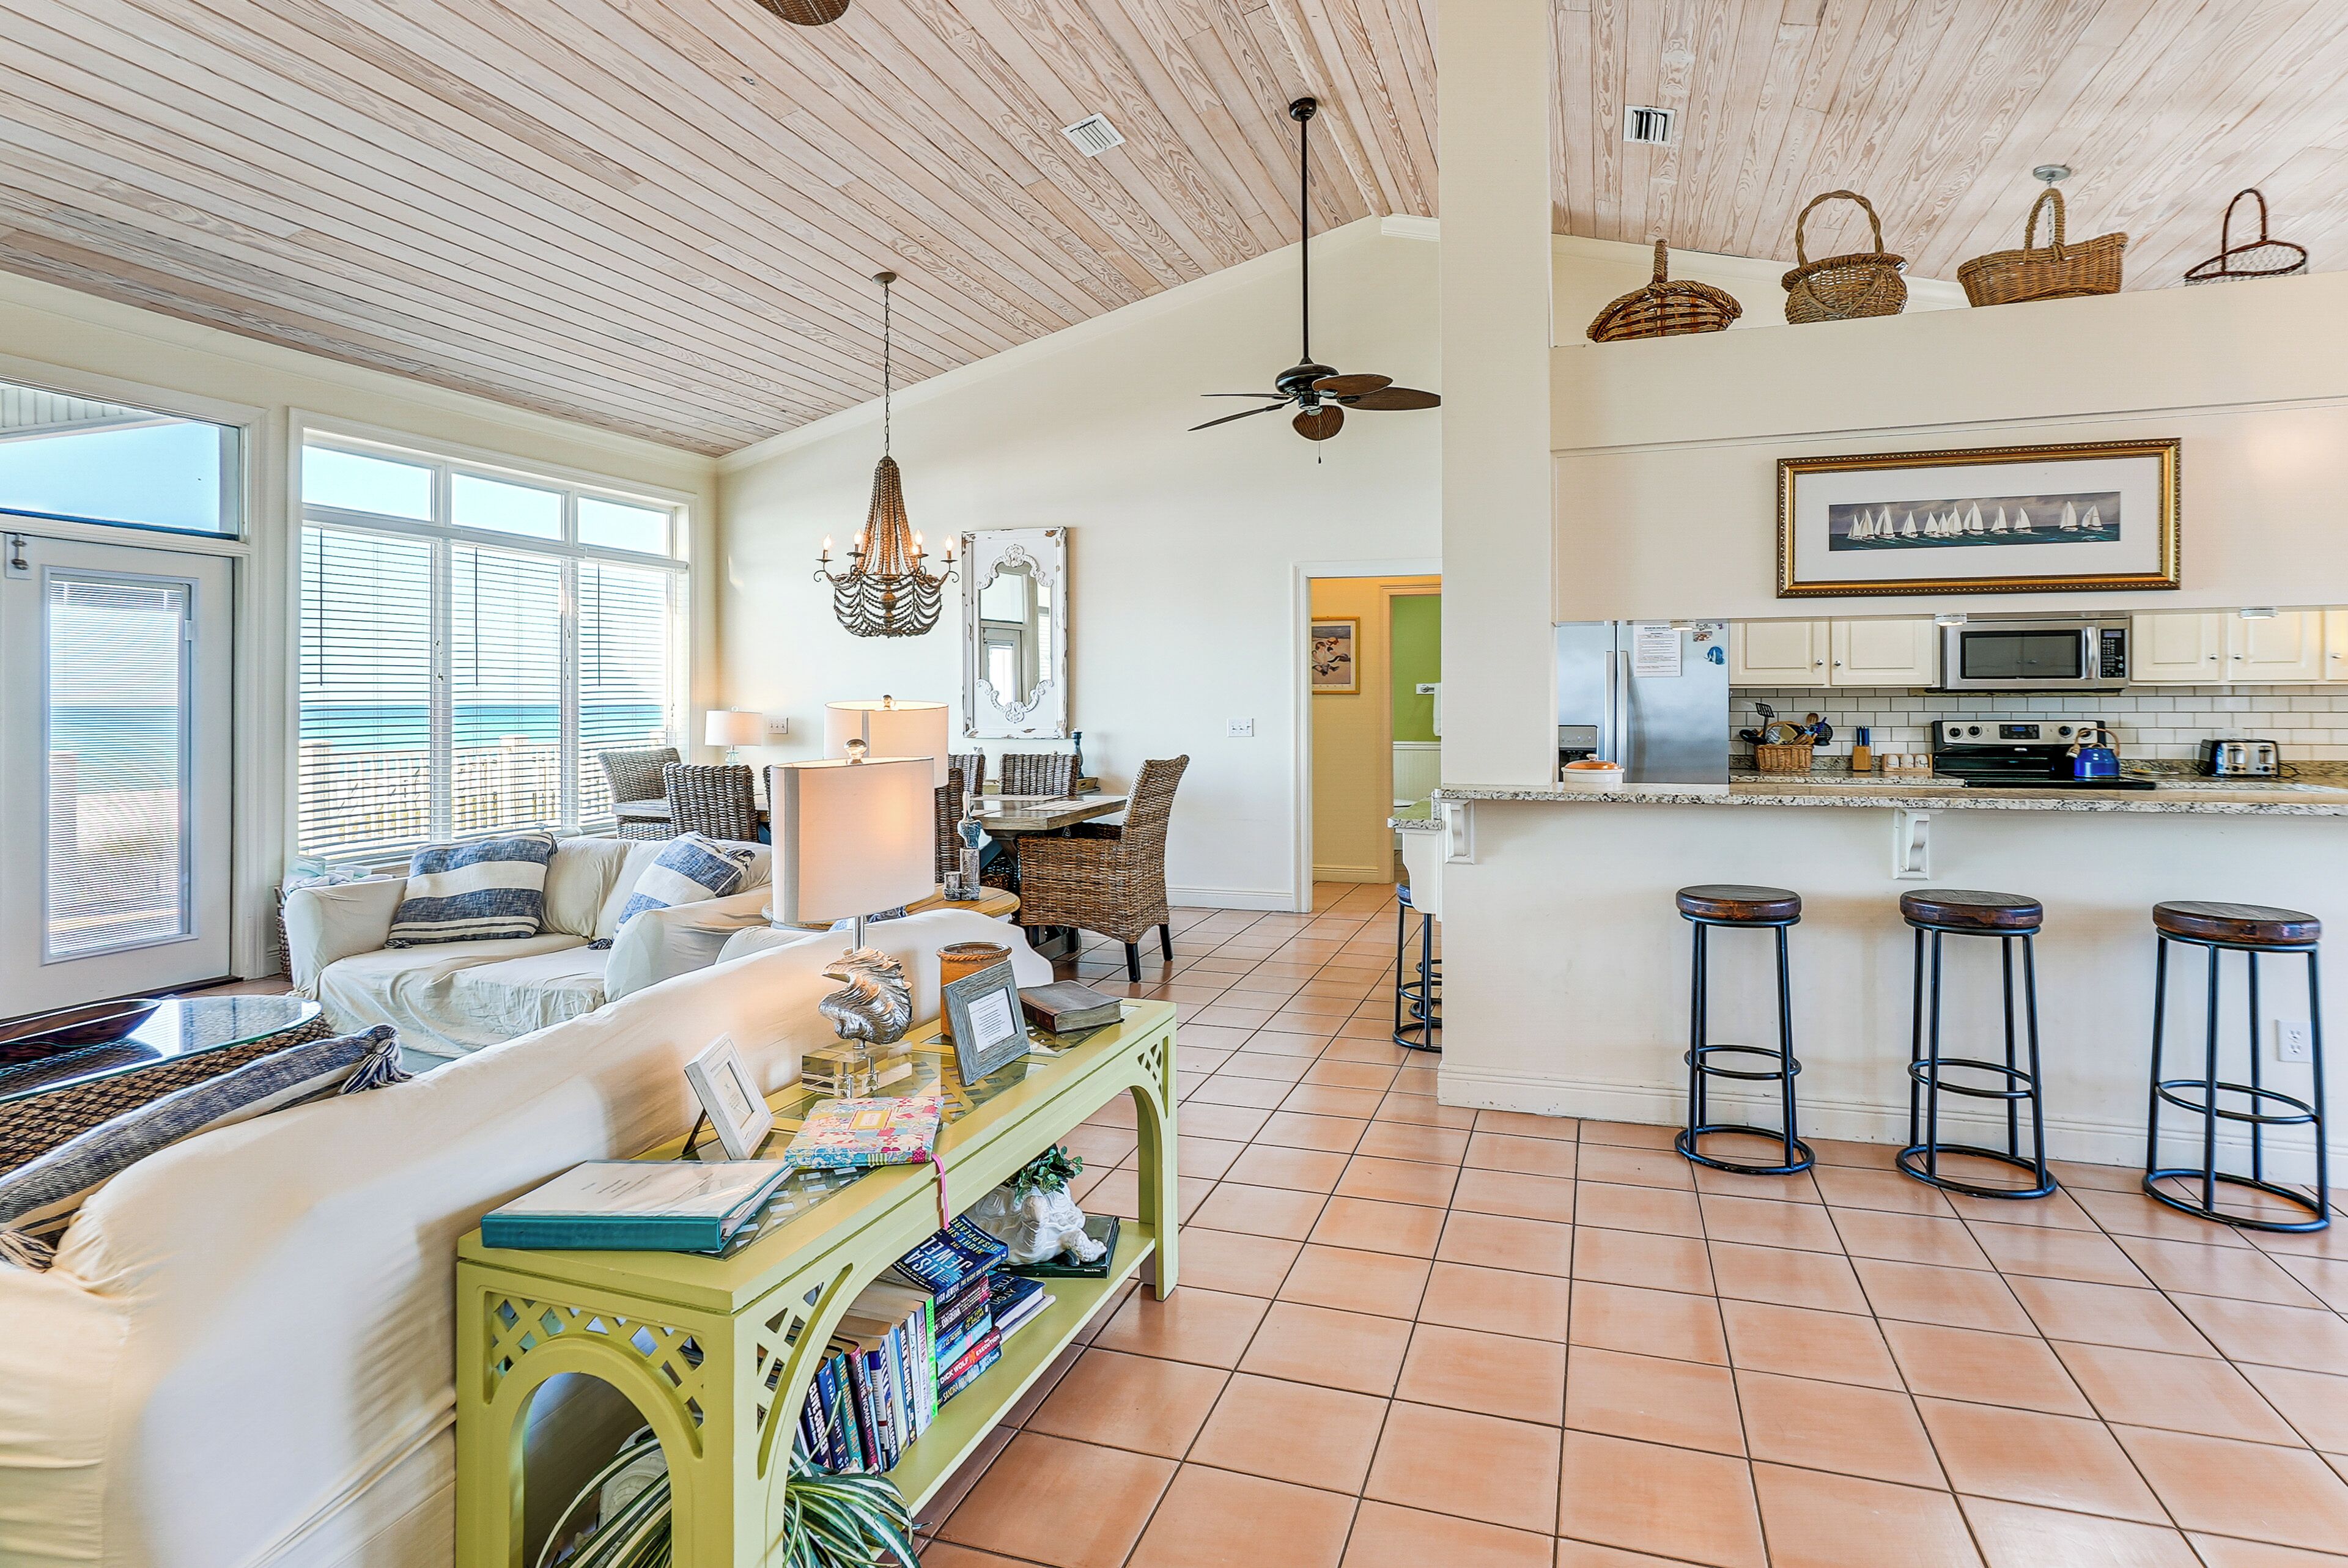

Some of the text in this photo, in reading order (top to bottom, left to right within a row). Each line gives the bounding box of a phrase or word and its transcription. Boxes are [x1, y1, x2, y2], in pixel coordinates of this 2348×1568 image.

[944, 1225, 960, 1239] SH
[950, 1218, 999, 1252] DISAPPEARE
[950, 1241, 961, 1250] THE
[959, 1237, 984, 1254] NIGHT
[904, 1250, 945, 1280] LISA
[920, 1236, 973, 1273] JEWEL
[936, 1292, 945, 1305] LISA
[945, 1283, 959, 1299] JEWELL
[967, 1272, 976, 1283] NIGHT
[982, 1254, 1002, 1272] DISAPPEARED
[989, 1288, 1016, 1305] UGLY
[975, 1334, 1000, 1356] EXECUTION
[903, 1361, 913, 1405] BEAUTIFUL
[940, 1369, 954, 1385] DICK
[953, 1356, 969, 1373] WOLF
[808, 1382, 819, 1410] CLIVE
[842, 1383, 855, 1427] MISSING
[855, 1353, 864, 1383] BEWARE
[862, 1396, 872, 1428] WOMAN
[943, 1382, 959, 1402] SANDRA
[827, 1378, 843, 1439] THAT IGHT
[888, 1413, 897, 1459] COLLECTOR
